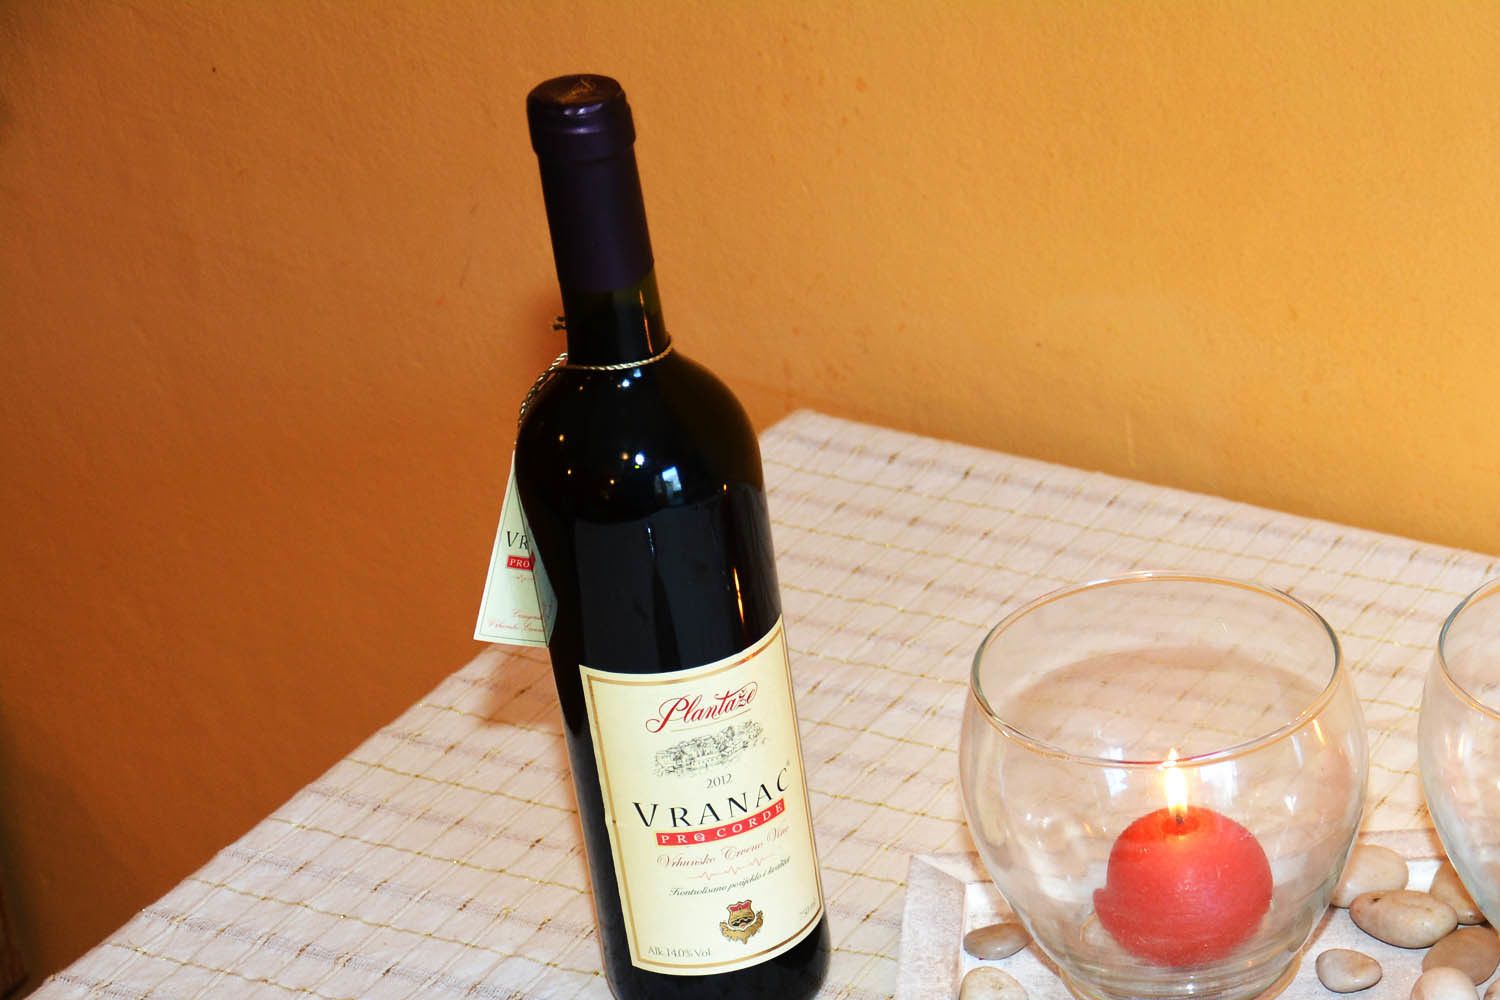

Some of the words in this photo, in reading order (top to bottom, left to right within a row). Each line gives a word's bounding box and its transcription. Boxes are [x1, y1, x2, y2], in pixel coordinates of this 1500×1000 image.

[509, 559, 530, 568] PRO
[645, 681, 758, 734] Plantaže
[632, 768, 789, 828] VRANAC
[706, 774, 732, 789] 2012
[661, 833, 705, 844] PRO
[716, 801, 784, 839] CORDE
